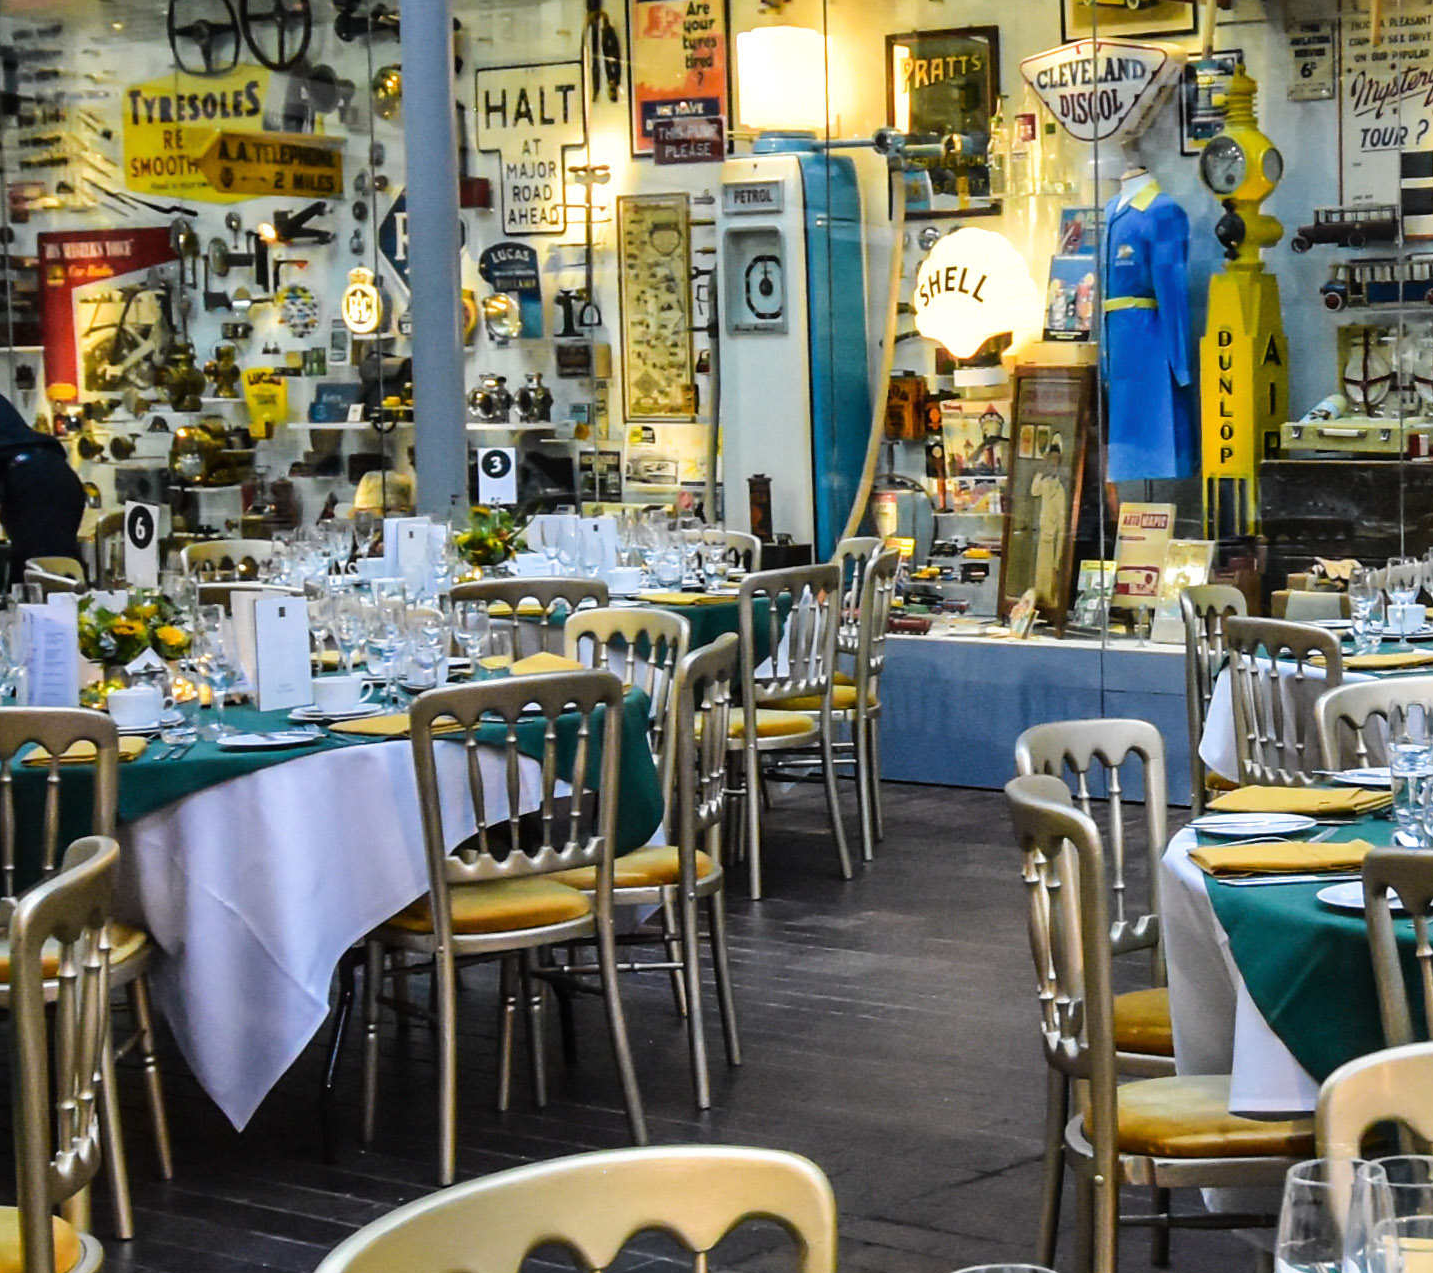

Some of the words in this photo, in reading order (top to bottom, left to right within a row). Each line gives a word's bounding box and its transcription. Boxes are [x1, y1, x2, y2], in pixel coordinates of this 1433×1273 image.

[686, 1, 711, 16] Are
[682, 17, 716, 35] your
[900, 54, 983, 94] PRATTS
[1035, 54, 1148, 91] CLEVELAND
[128, 79, 261, 126] TYRESOLES
[482, 83, 577, 129] HALT
[675, 102, 705, 115] HAVE
[1059, 88, 1124, 126] DISCOL
[1359, 126, 1409, 149] TOUR
[1415, 118, 1431, 146] ?
[521, 138, 543, 156] AT
[664, 142, 712, 159] PLEASE
[505, 159, 557, 181] MAJOR
[273, 171, 285, 190] 2
[291, 171, 336, 193] MILES
[512, 184, 553, 202] ROAD
[733, 188, 773, 205] PETROL
[507, 207, 559, 226] AHEAD
[490, 247, 531, 264] LUCAS
[918, 265, 989, 308] SHELL
[1217, 329, 1234, 465] DUNLOP
[1260, 334, 1283, 462] AIR
[490, 456, 503, 474] 3
[134, 516, 146, 540] 6
